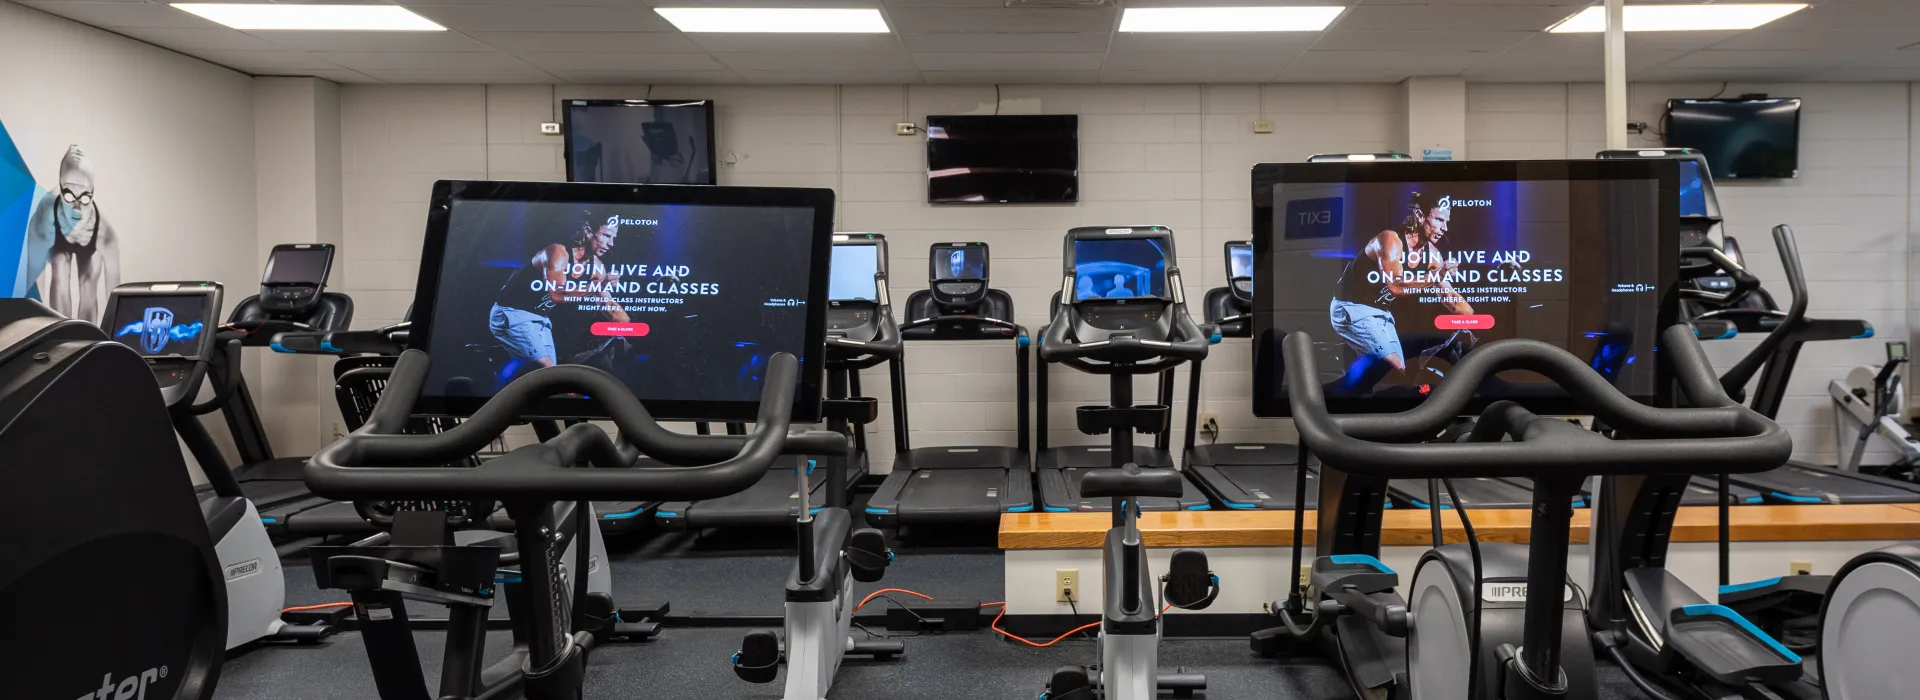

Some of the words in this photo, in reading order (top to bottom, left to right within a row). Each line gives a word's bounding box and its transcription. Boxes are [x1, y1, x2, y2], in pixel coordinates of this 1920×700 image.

[1452, 199, 1492, 207] PELOTON
[620, 218, 658, 226] PELOTON
[1399, 251, 1441, 264] JOIN
[1448, 250, 1486, 264] LIVE
[1491, 250, 1531, 263] AND
[563, 263, 605, 275] JOIN
[610, 264, 648, 276] LIVE
[652, 265, 690, 277] AND
[1367, 270, 1481, 284] ON-DEMAND
[1487, 269, 1563, 283] CLASSES
[530, 280, 641, 293] ON-DEMAND
[646, 282, 719, 295] CLASSES
